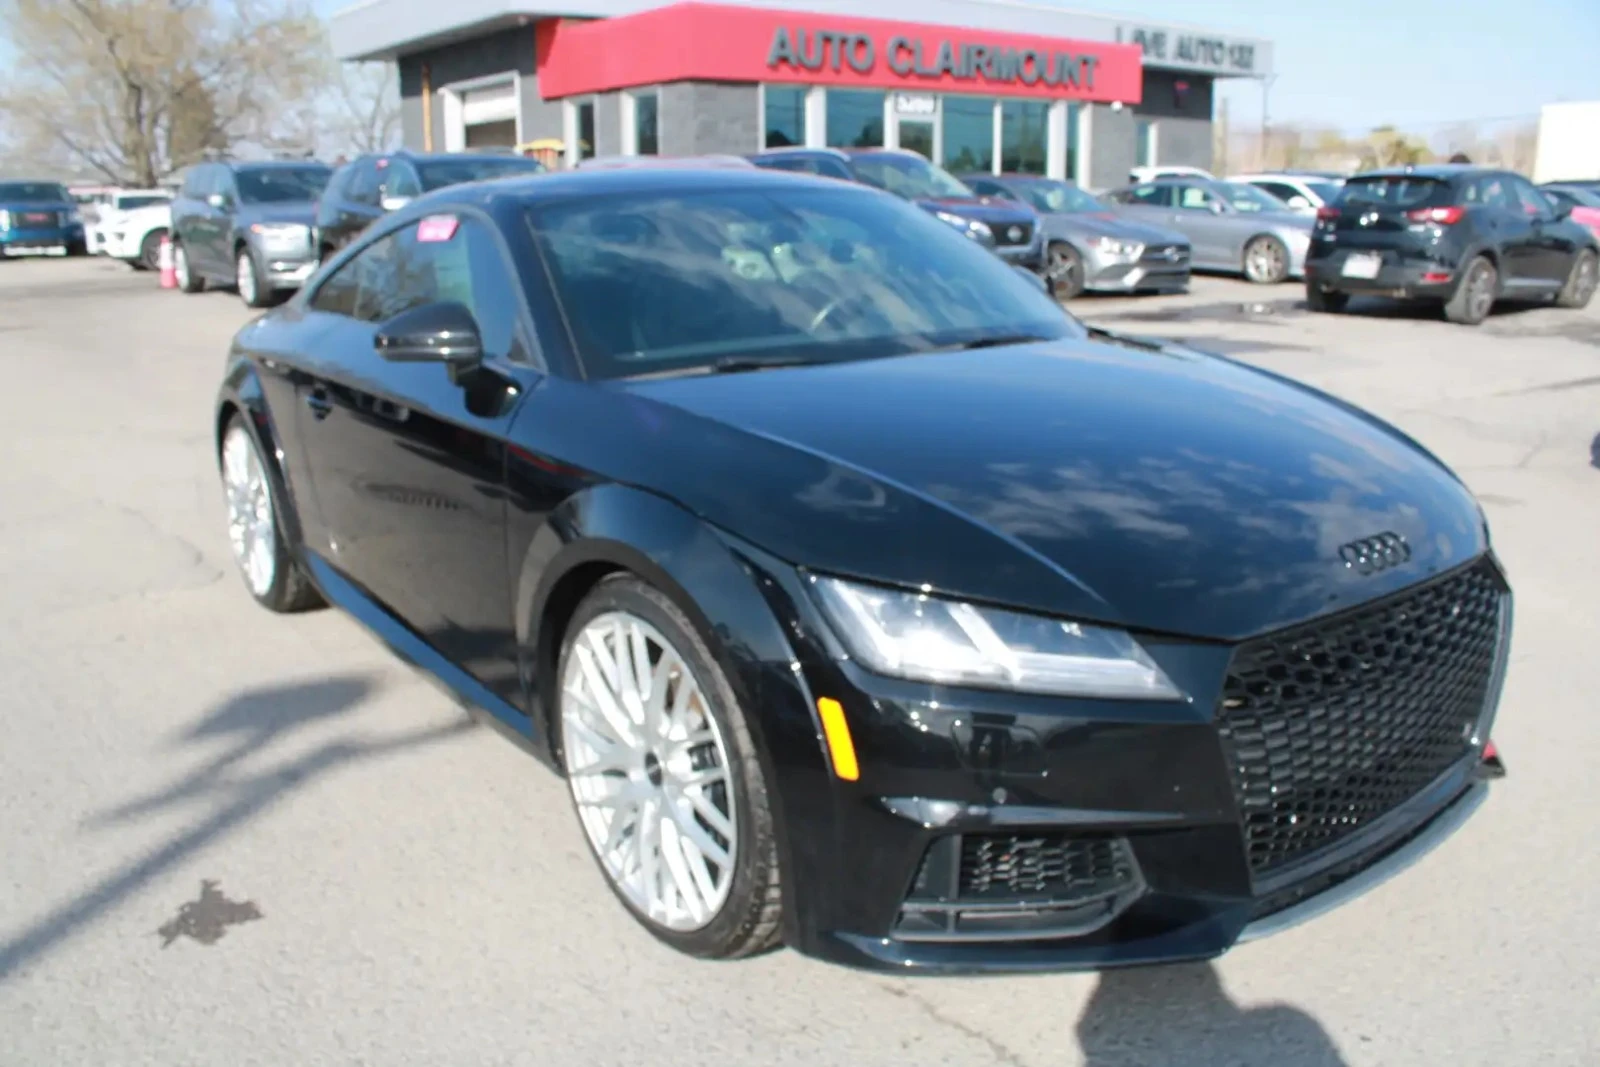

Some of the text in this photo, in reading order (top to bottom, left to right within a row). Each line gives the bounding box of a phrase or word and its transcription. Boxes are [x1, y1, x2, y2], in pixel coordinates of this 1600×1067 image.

[767, 27, 1099, 90] AUTO CLAIRMOUNT
[1174, 37, 1224, 65] AUTO
